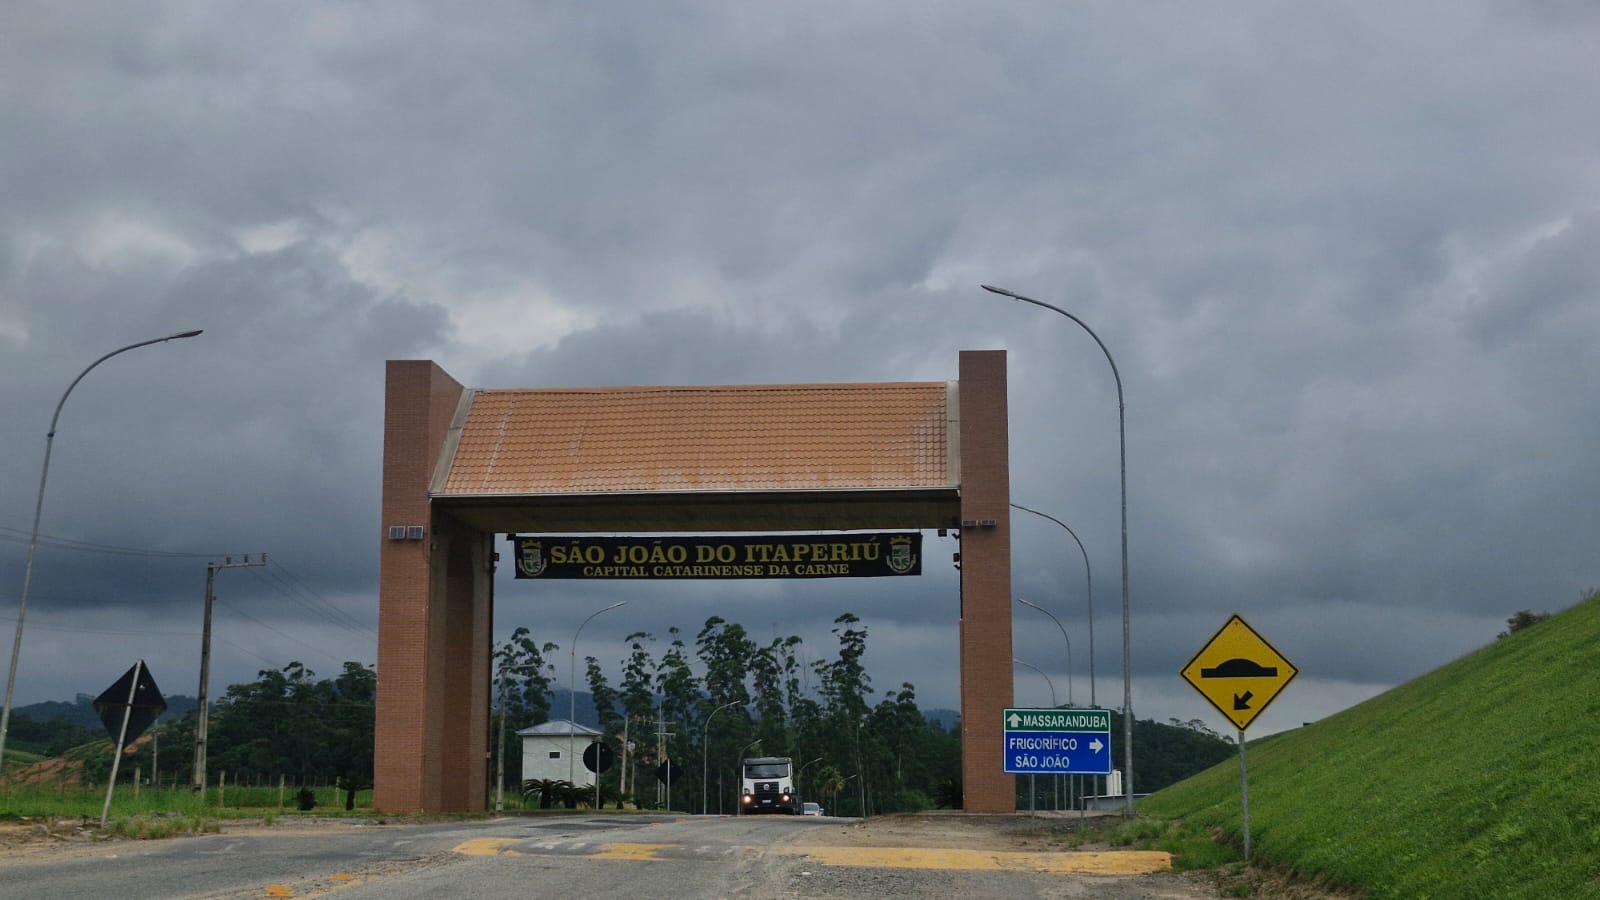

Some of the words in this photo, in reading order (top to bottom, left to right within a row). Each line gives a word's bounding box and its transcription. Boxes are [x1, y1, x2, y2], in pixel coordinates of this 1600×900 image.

[550, 541, 605, 564] SÃO
[613, 541, 688, 564] JOÃO
[696, 545, 736, 563] DO
[744, 536, 881, 563] ITAPERIÚ
[583, 566, 649, 577] CAPITAL
[653, 564, 764, 577] CATARINENSE
[769, 564, 791, 576] DA
[794, 563, 849, 575] CARNE
[1023, 715, 1107, 728] MASSARANDUBA
[1009, 735, 1078, 751] FRIGORÍFICO
[1015, 753, 1038, 768] SÃO
[1040, 753, 1070, 768] JOÃO
